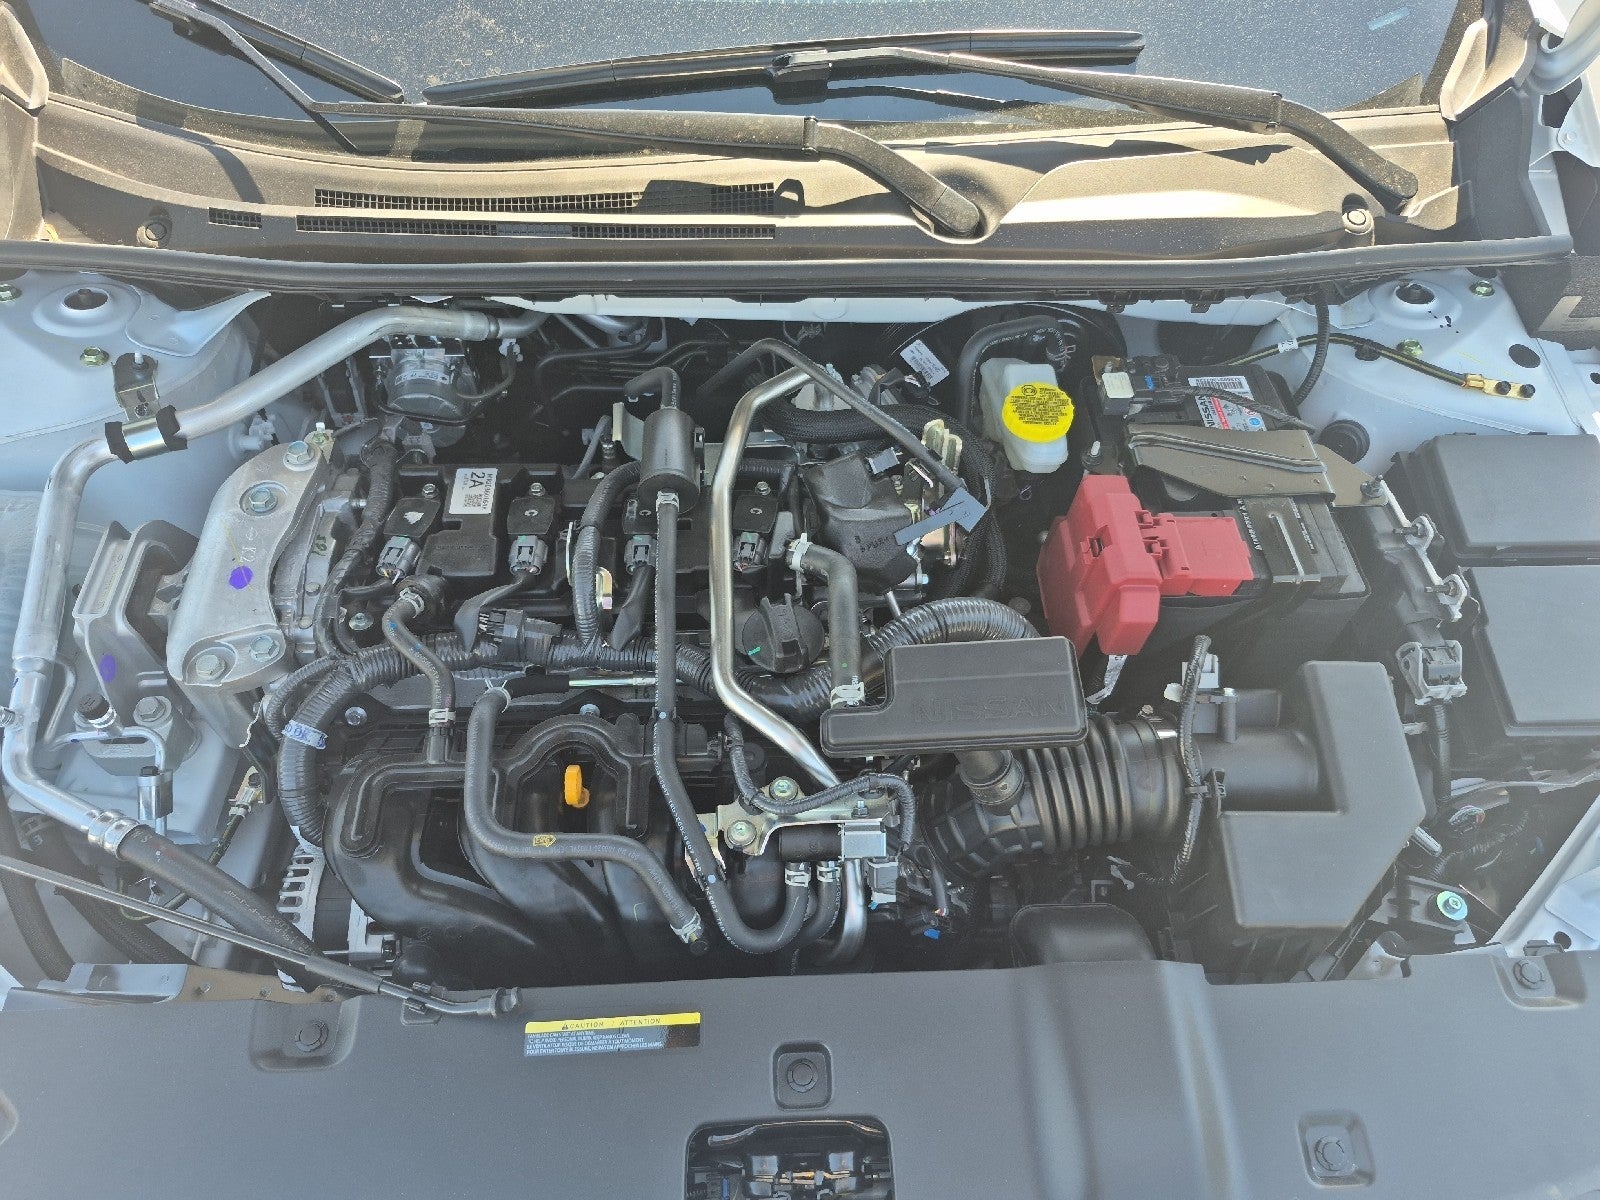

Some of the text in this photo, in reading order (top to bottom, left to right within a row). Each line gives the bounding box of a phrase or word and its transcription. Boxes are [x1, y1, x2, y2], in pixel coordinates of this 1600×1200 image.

[469, 472, 486, 488] 2A
[913, 696, 1069, 722] NISSAN
[569, 1021, 604, 1029] CAUTION
[619, 1018, 661, 1026] ATTENTION
